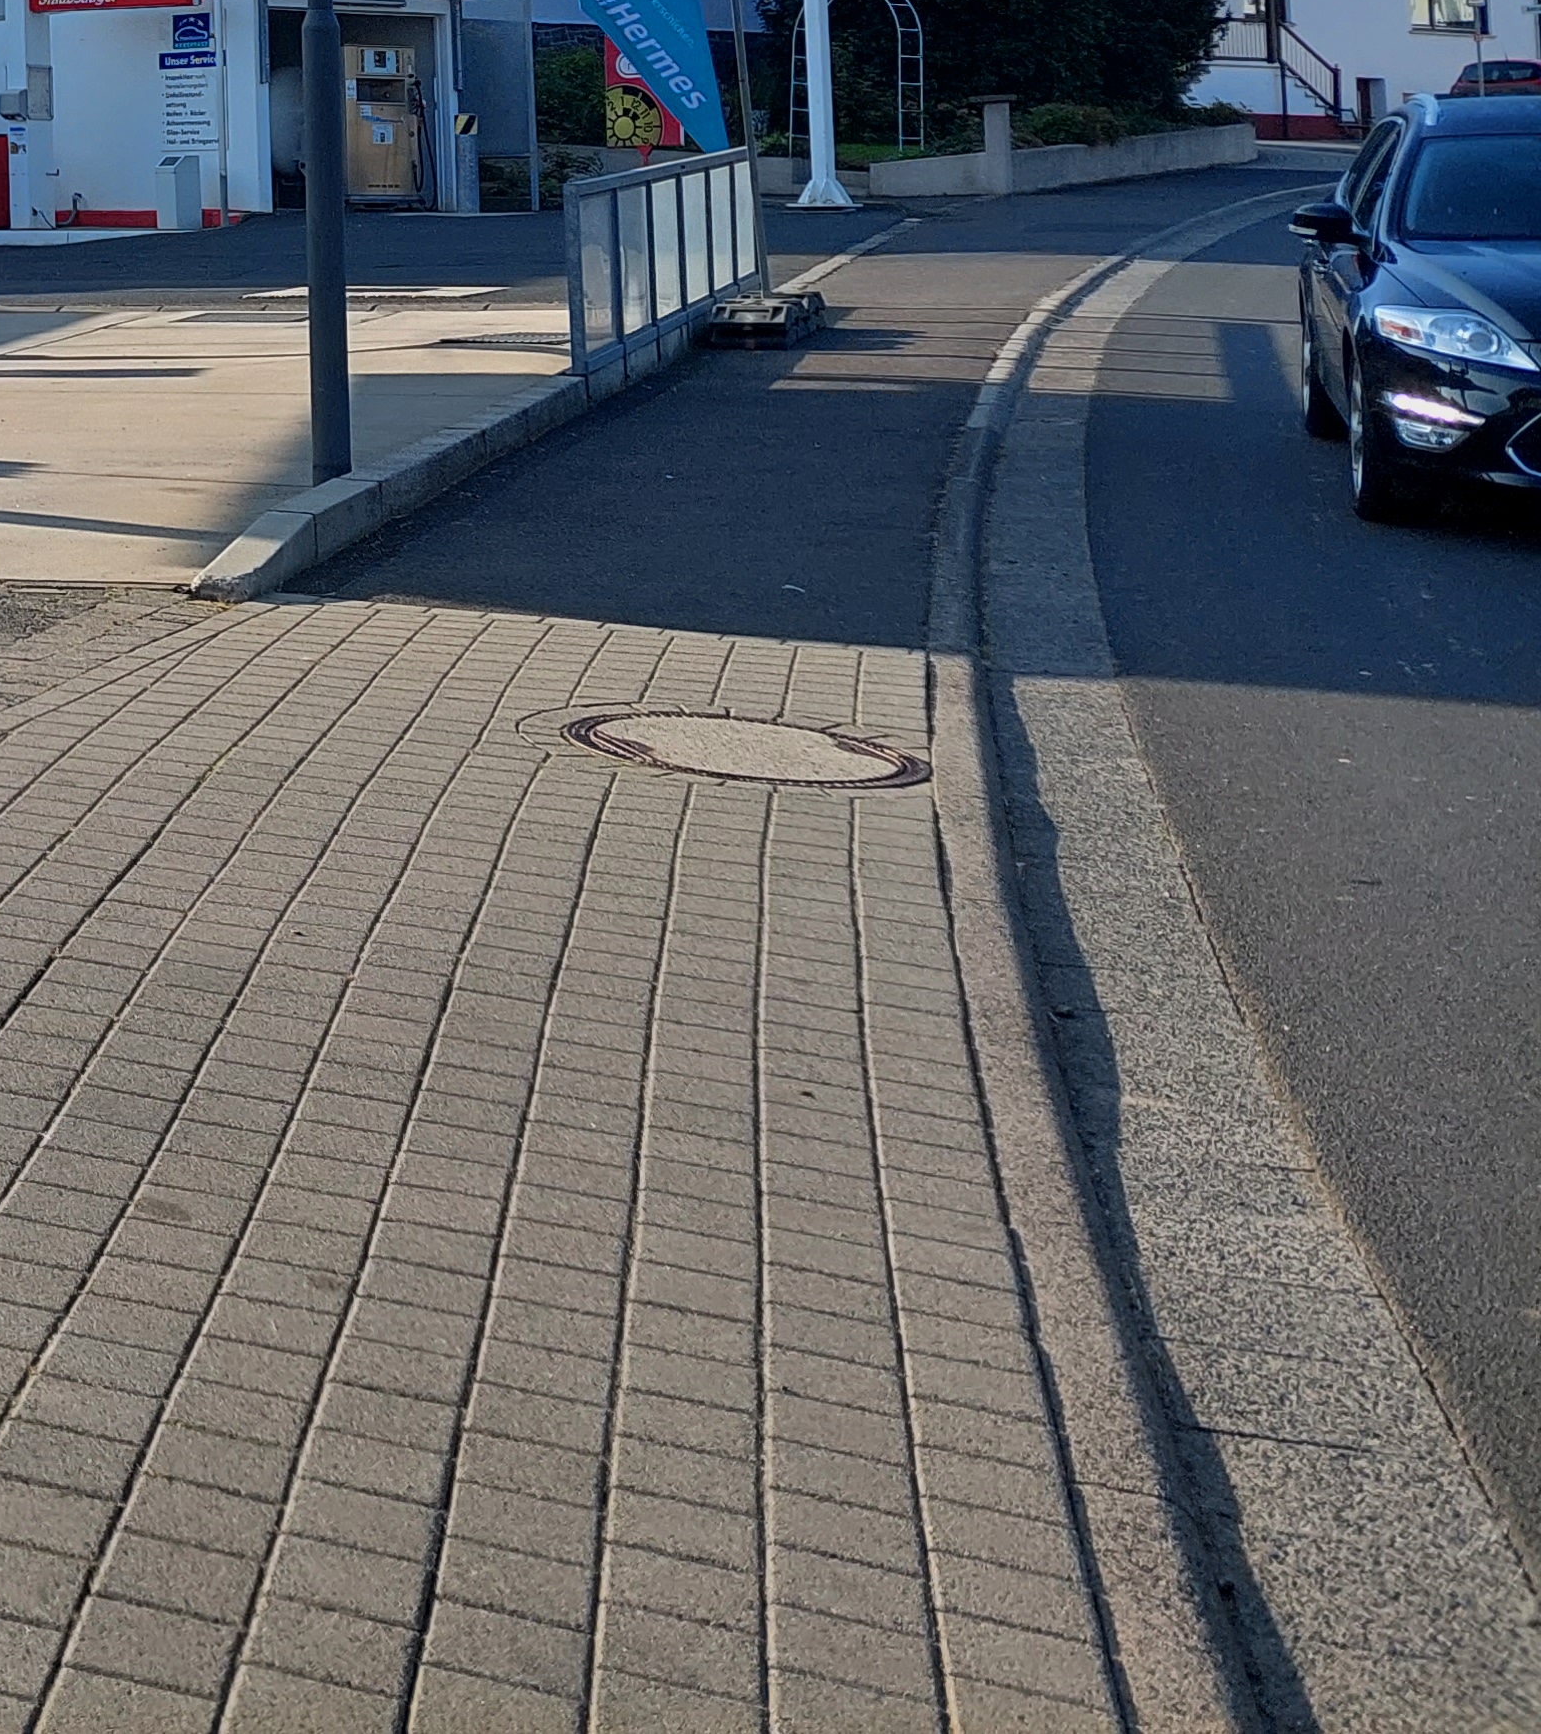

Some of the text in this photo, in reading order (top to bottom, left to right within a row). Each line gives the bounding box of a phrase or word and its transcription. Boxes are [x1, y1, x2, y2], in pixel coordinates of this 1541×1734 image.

[165, 56, 188, 66] Unser
[607, 2, 708, 110] Hermes
[608, 101, 616, 111] 2
[631, 98, 642, 111] 12
[644, 121, 653, 133] 10
